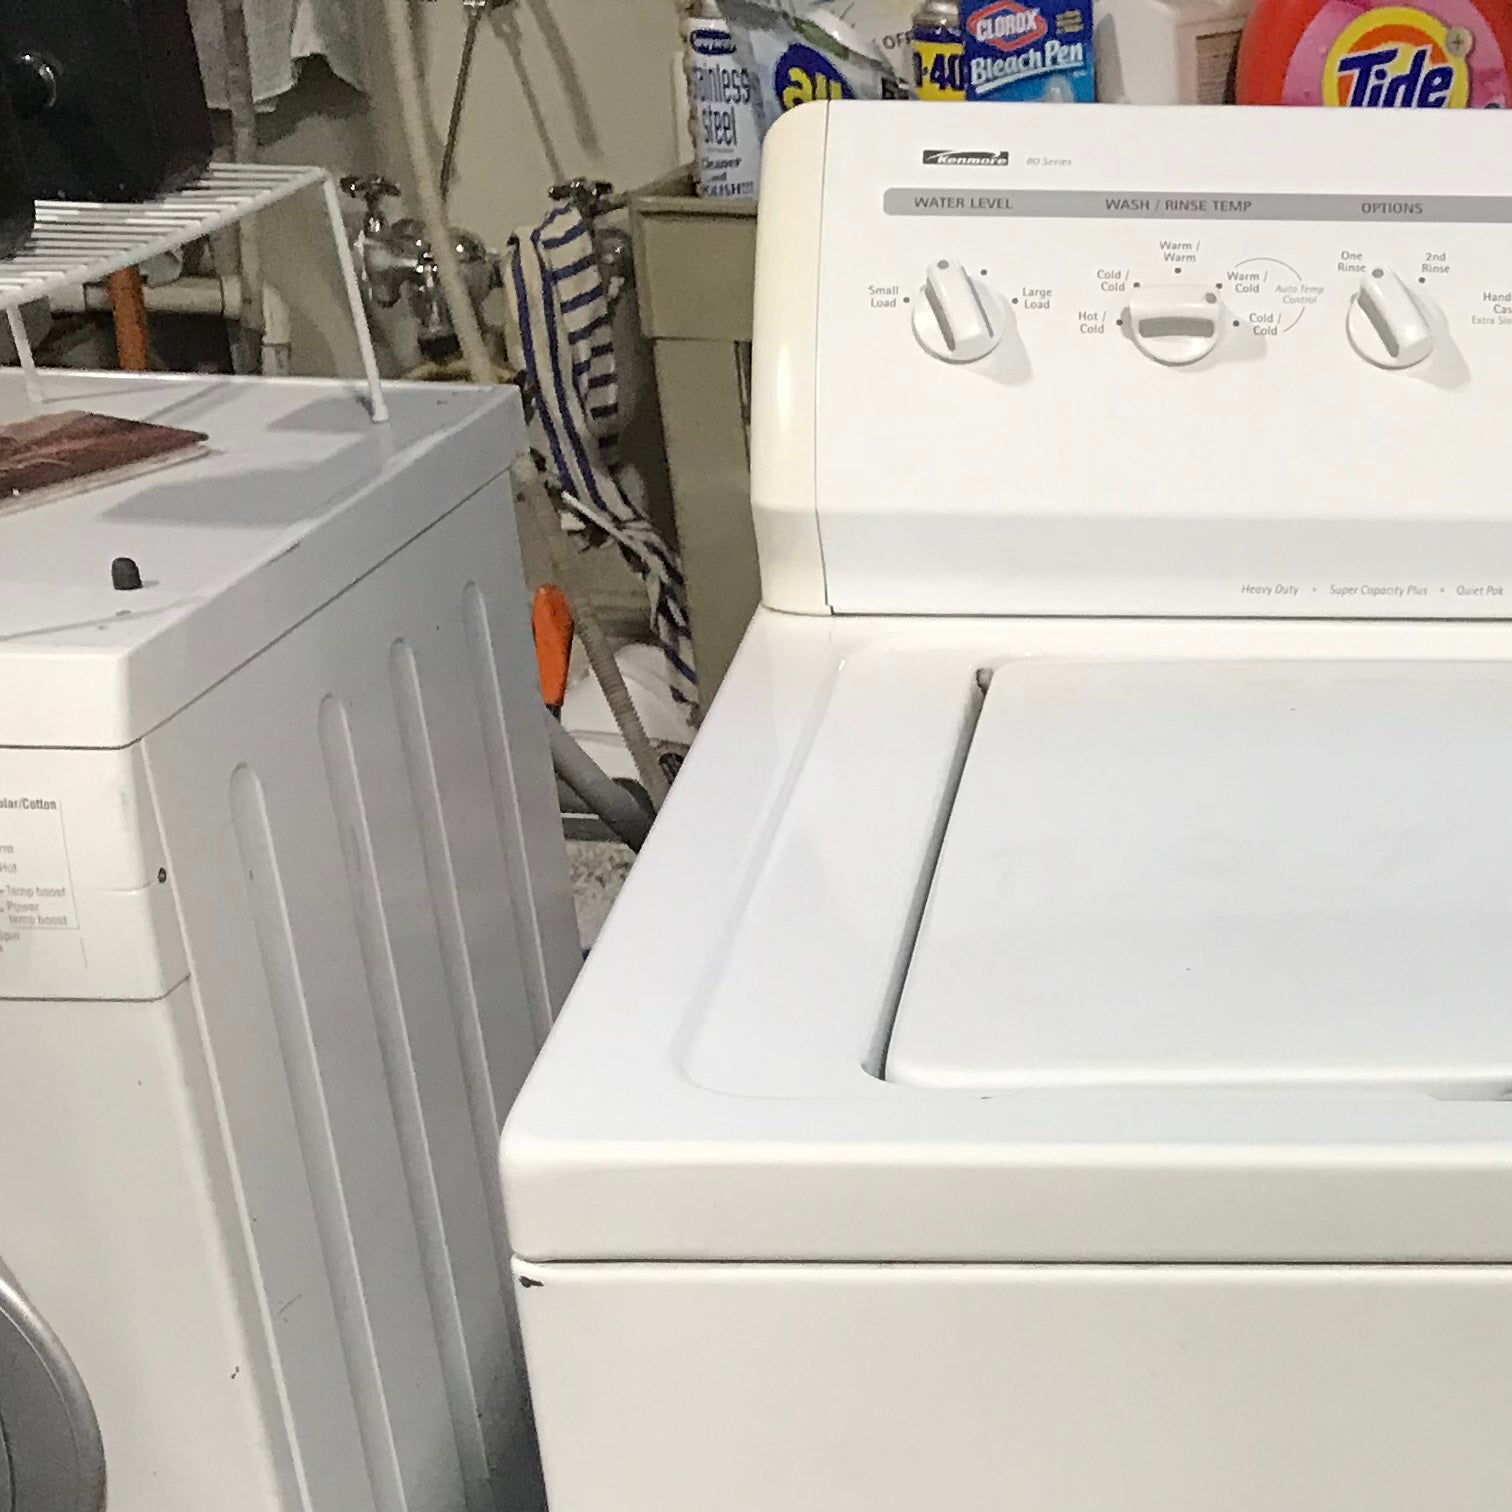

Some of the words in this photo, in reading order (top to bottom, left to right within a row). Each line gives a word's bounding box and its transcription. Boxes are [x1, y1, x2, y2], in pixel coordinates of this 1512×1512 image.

[975, 8, 1041, 42] CLOROX
[969, 48, 1042, 85] Bleach
[1044, 40, 1084, 67] Pen
[1337, 46, 1454, 107] Tide
[932, 152, 1008, 166] Kenmore
[1042, 157, 1072, 167] Series
[914, 197, 965, 209] WATER
[970, 198, 1013, 210] LEVEL
[1105, 199, 1150, 211] WASH
[1165, 200, 1207, 212] RINSE
[1212, 200, 1252, 212] TEMP
[1361, 202, 1423, 215] OPTIONS
[1160, 241, 1193, 251] Warm
[1163, 253, 1196, 263] Warm
[1341, 251, 1363, 261] One
[1426, 252, 1446, 262] 2nd
[1338, 262, 1367, 273] Rinse
[1421, 263, 1450, 273] Rinse
[1097, 269, 1121, 280] Cold
[1227, 271, 1260, 281] Warm
[868, 285, 899, 295] Small
[1101, 281, 1125, 292] Cold
[1235, 283, 1259, 294] Cold
[1275, 284, 1298, 294] Auto
[1300, 284, 1325, 295] Temp
[1022, 287, 1052, 298] Large
[870, 297, 896, 308] Load
[1024, 298, 1050, 309] Load
[1282, 295, 1317, 304] Control
[1078, 311, 1098, 321] Hot
[1249, 312, 1274, 323] Cold
[1471, 316, 1495, 326] Extra
[1080, 323, 1105, 334] Cold
[1253, 325, 1278, 336] Cold
[1241, 583, 1273, 597] Heavy
[1274, 583, 1299, 597] Duty
[1329, 584, 1358, 597] Super
[1360, 584, 1405, 598] Capacity
[1406, 584, 1428, 596] Plus
[1456, 584, 1484, 596] Quiet
[1485, 585, 1504, 596] Pak
